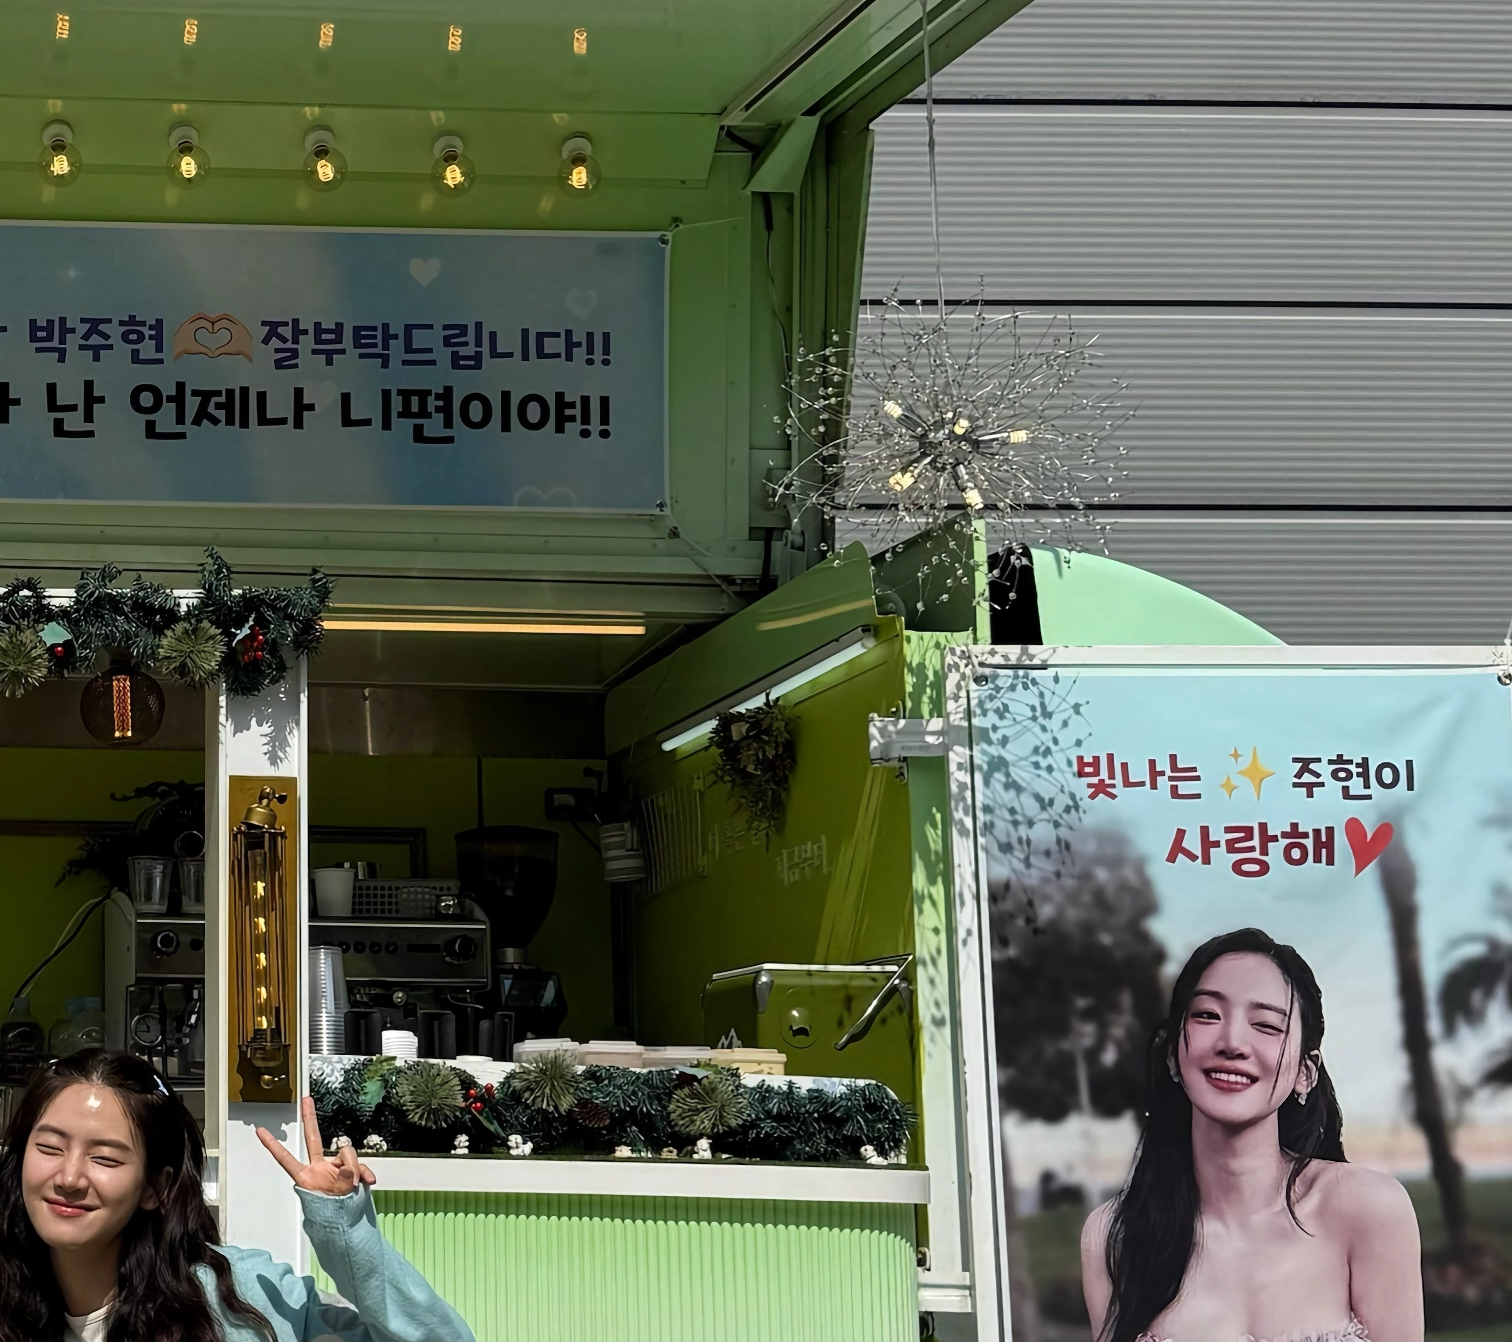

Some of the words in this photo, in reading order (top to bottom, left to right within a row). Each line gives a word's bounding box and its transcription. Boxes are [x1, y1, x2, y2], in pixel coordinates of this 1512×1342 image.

[28, 315, 166, 366] 박주현
[259, 318, 613, 370] 잘부탁드립니다!!
[46, 379, 105, 440] 난
[129, 381, 316, 441] 언제나
[341, 384, 613, 445] 니편이야!!
[1075, 752, 1203, 801] 빛나는
[1291, 753, 1416, 801] 주현이
[1164, 821, 1336, 879] 사랑해
